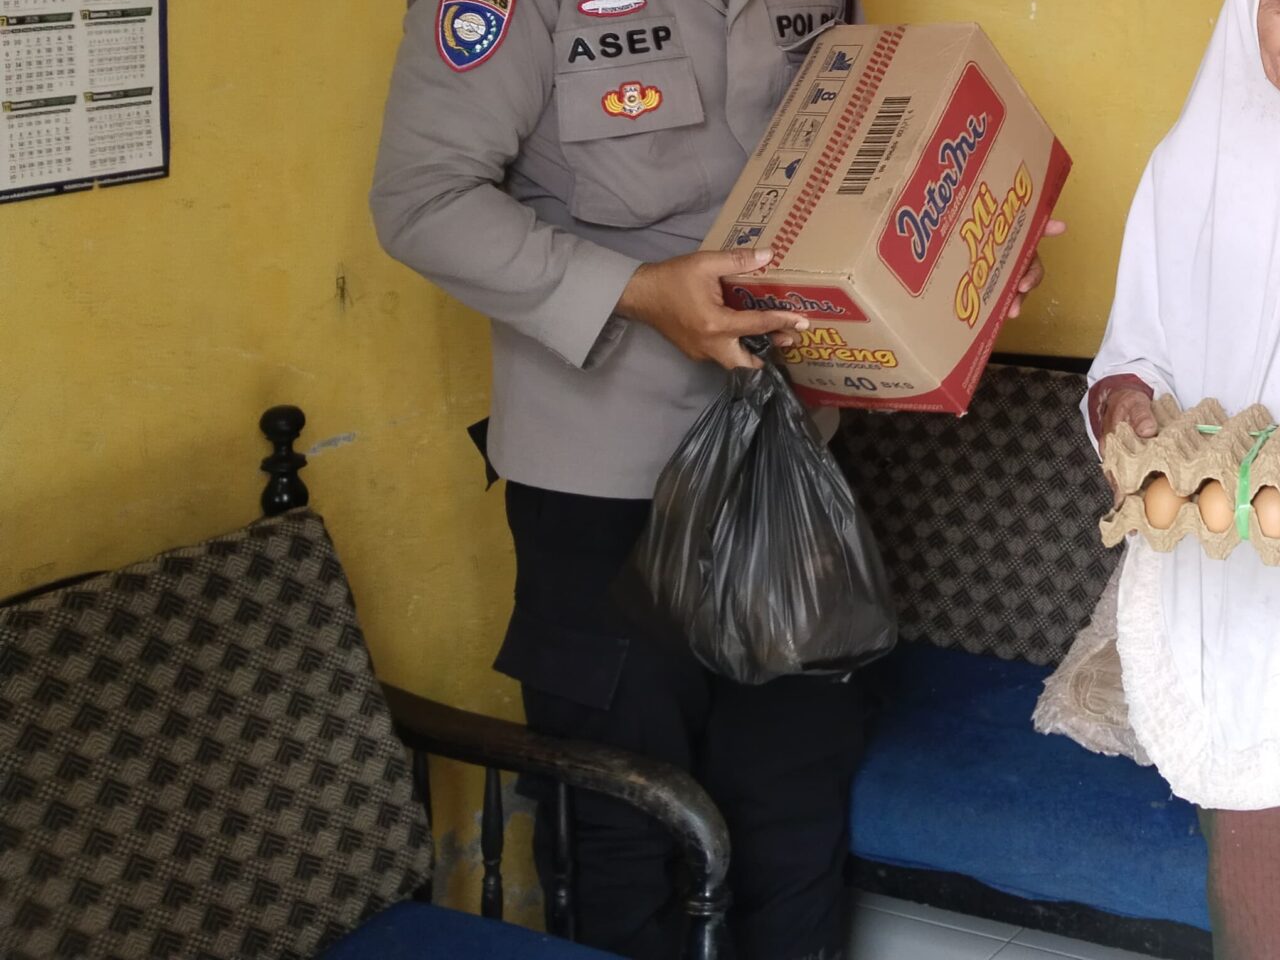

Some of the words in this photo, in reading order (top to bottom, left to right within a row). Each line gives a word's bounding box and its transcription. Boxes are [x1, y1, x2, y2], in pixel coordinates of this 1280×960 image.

[568, 25, 672, 63] ASEP
[955, 161, 1033, 328] Goreng
[960, 182, 998, 261] Mi
[844, 376, 877, 391] 40
